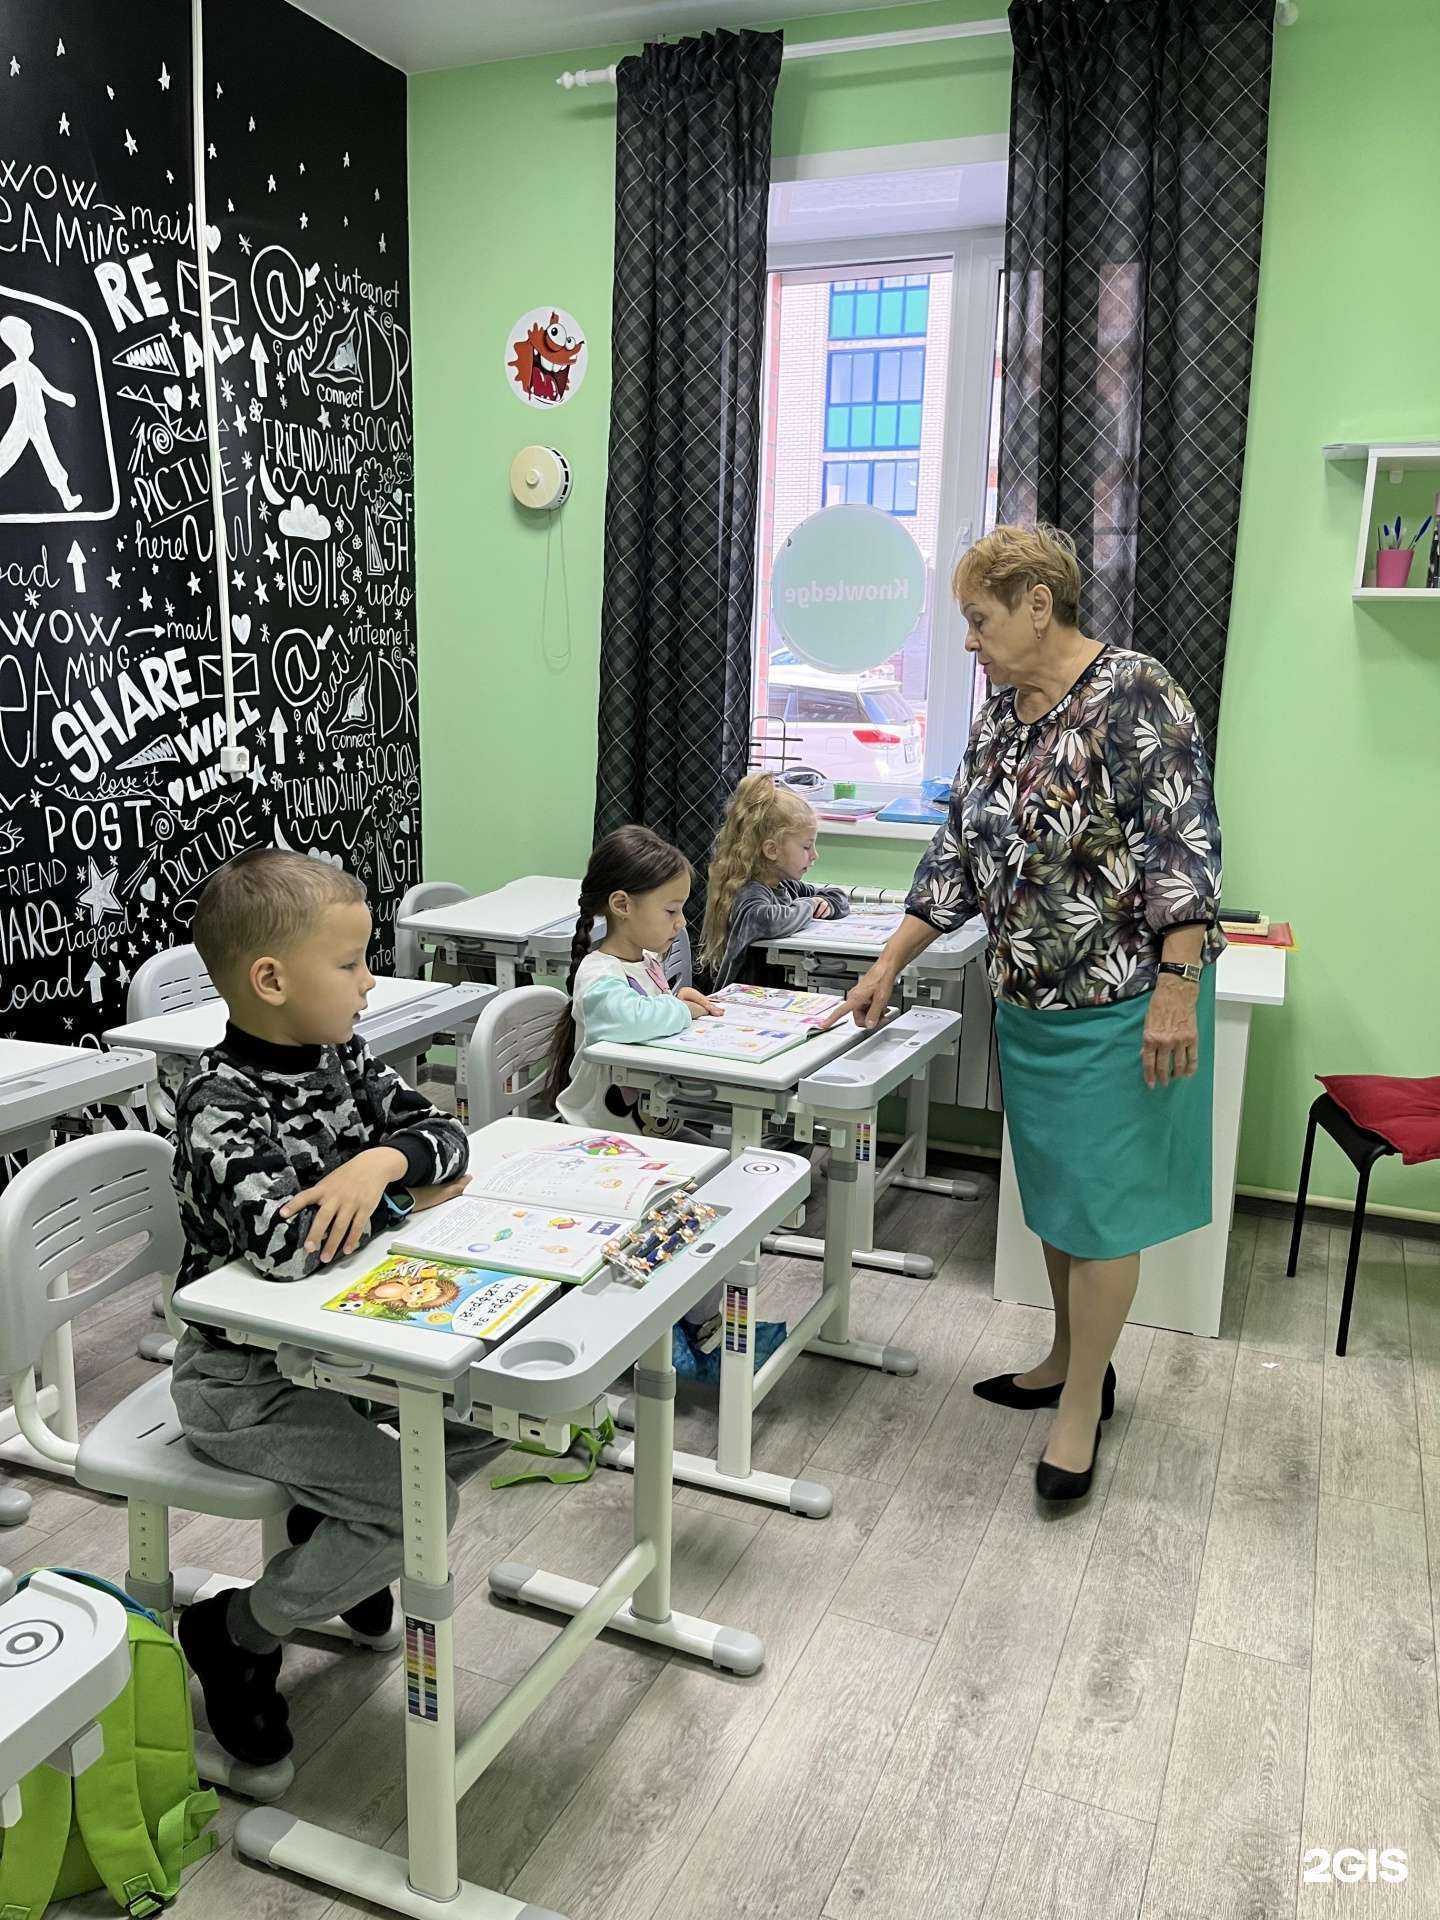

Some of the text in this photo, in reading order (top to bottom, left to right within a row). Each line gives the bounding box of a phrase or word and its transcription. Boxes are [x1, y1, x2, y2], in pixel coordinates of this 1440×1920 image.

[0, 159, 97, 211] WOW
[131, 203, 196, 250] mail
[94, 252, 170, 333] RE
[334, 263, 400, 308] internet
[287, 277, 341, 396] great!
[316, 383, 364, 408] connect
[135, 519, 185, 560] here
[0, 609, 122, 647] WOW
[166, 605, 218, 642] mail
[348, 617, 411, 647] internet
[52, 646, 200, 783] SHARE
[304, 633, 355, 752] great!
[331, 727, 377, 749] connect
[97, 765, 164, 795] love it
[185, 763, 244, 802] LIK
[45, 800, 152, 854] POST
[63, 902, 138, 959] tagged
